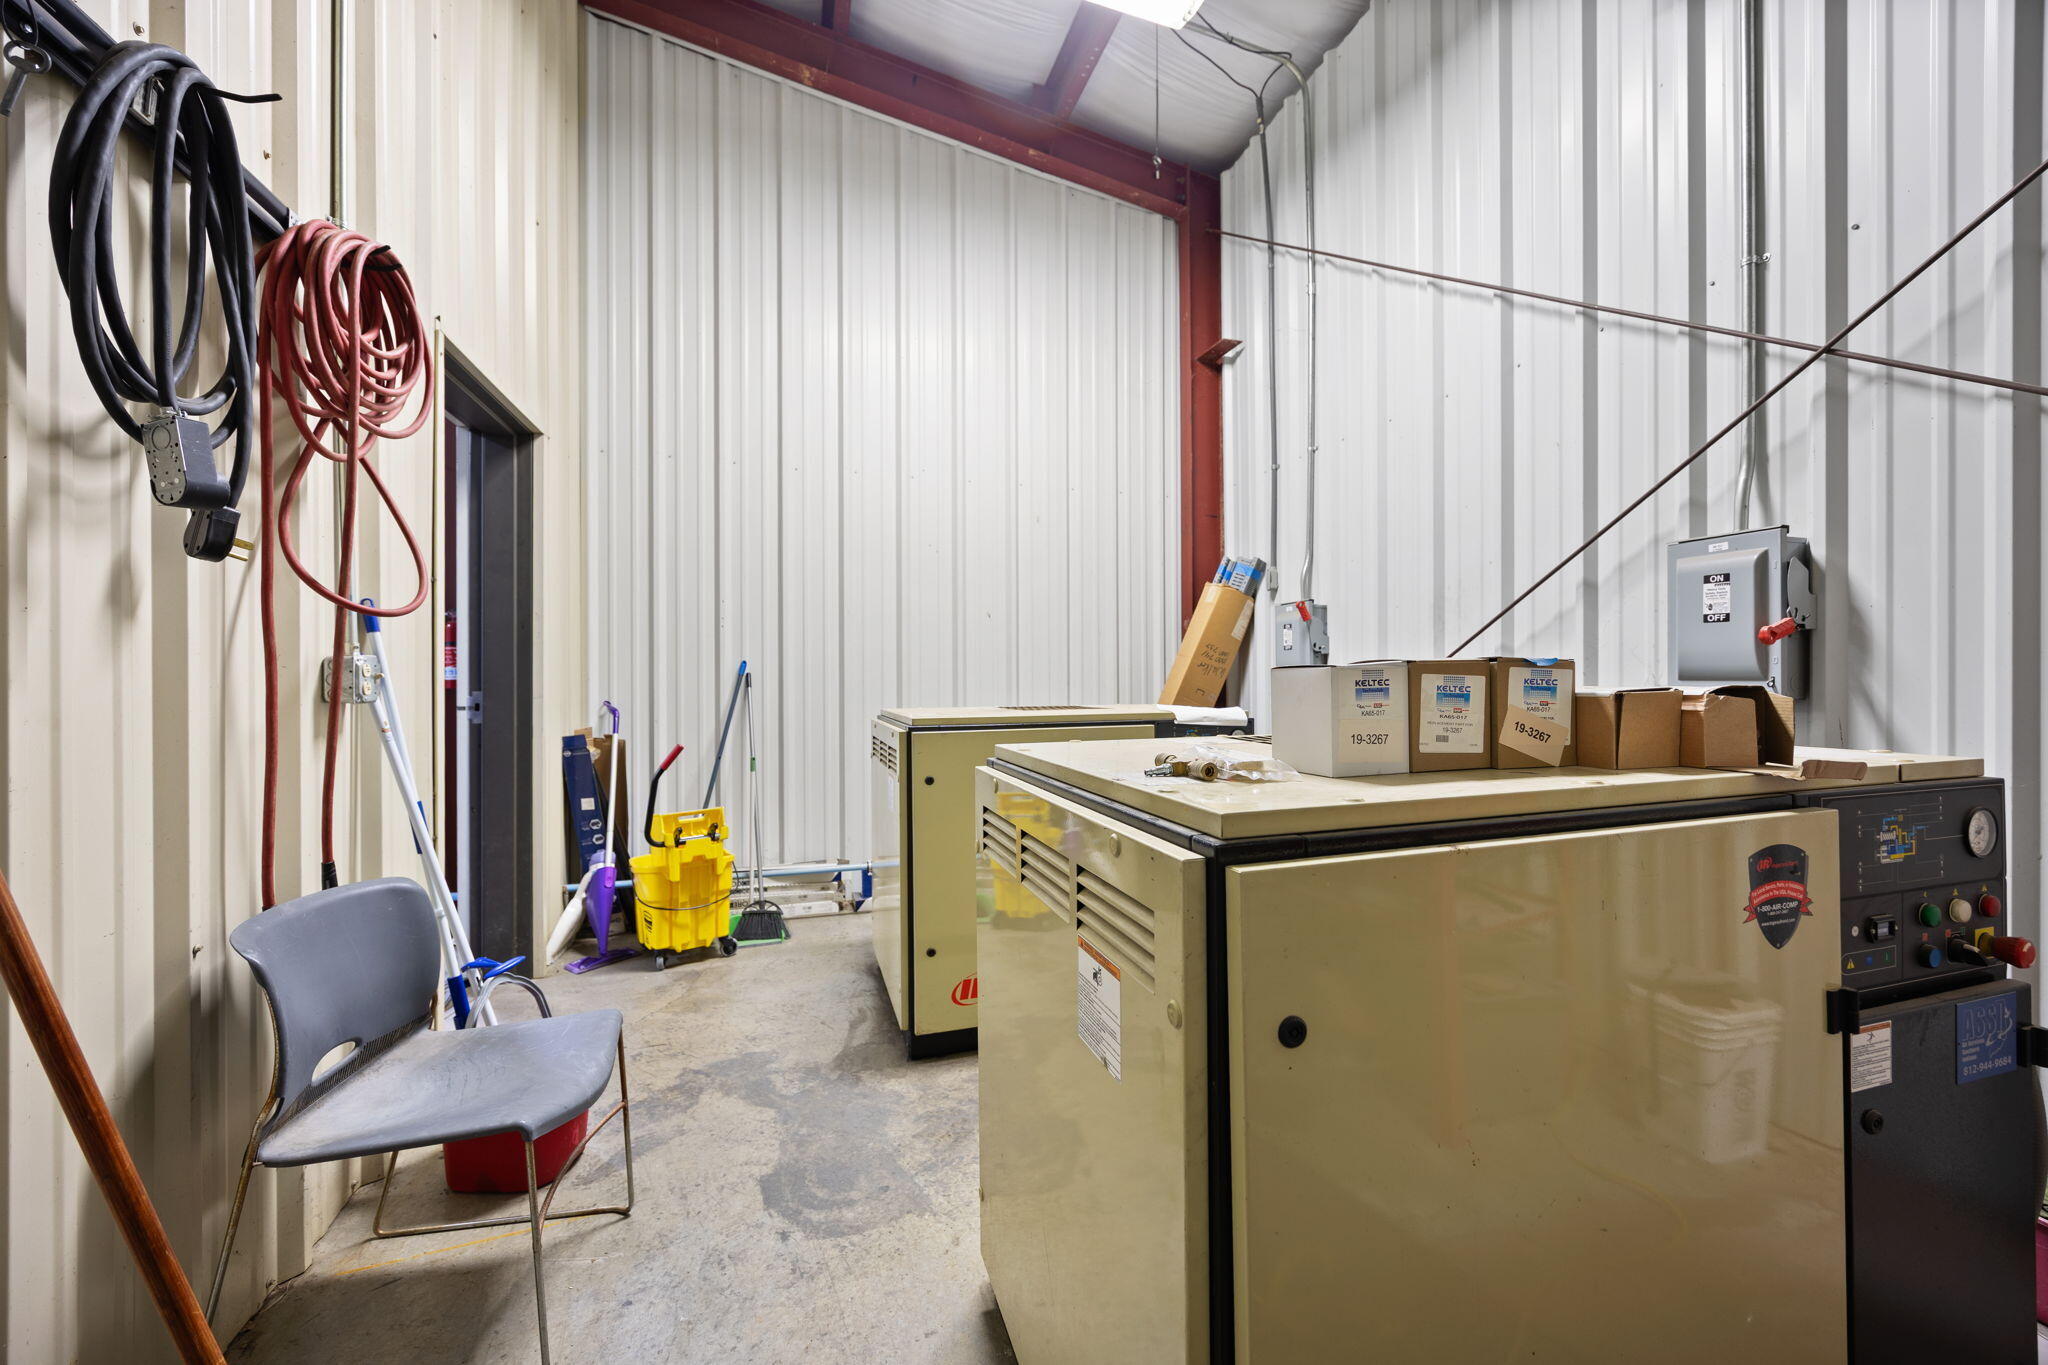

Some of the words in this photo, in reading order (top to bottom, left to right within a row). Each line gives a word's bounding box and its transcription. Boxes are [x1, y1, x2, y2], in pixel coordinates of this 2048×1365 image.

[1709, 574, 1724, 583] ON
[1707, 613, 1726, 622] OFF
[1355, 679, 1390, 688] KELTEC
[1523, 678, 1559, 686] KELTEC
[1436, 684, 1472, 693] KELTEC
[1514, 721, 1552, 743] 19-3267
[1351, 733, 1389, 745] 19-3267
[1757, 901, 1799, 912] 1-800-AIR-COMP
[1963, 1056, 2012, 1076] 812-944-9684
